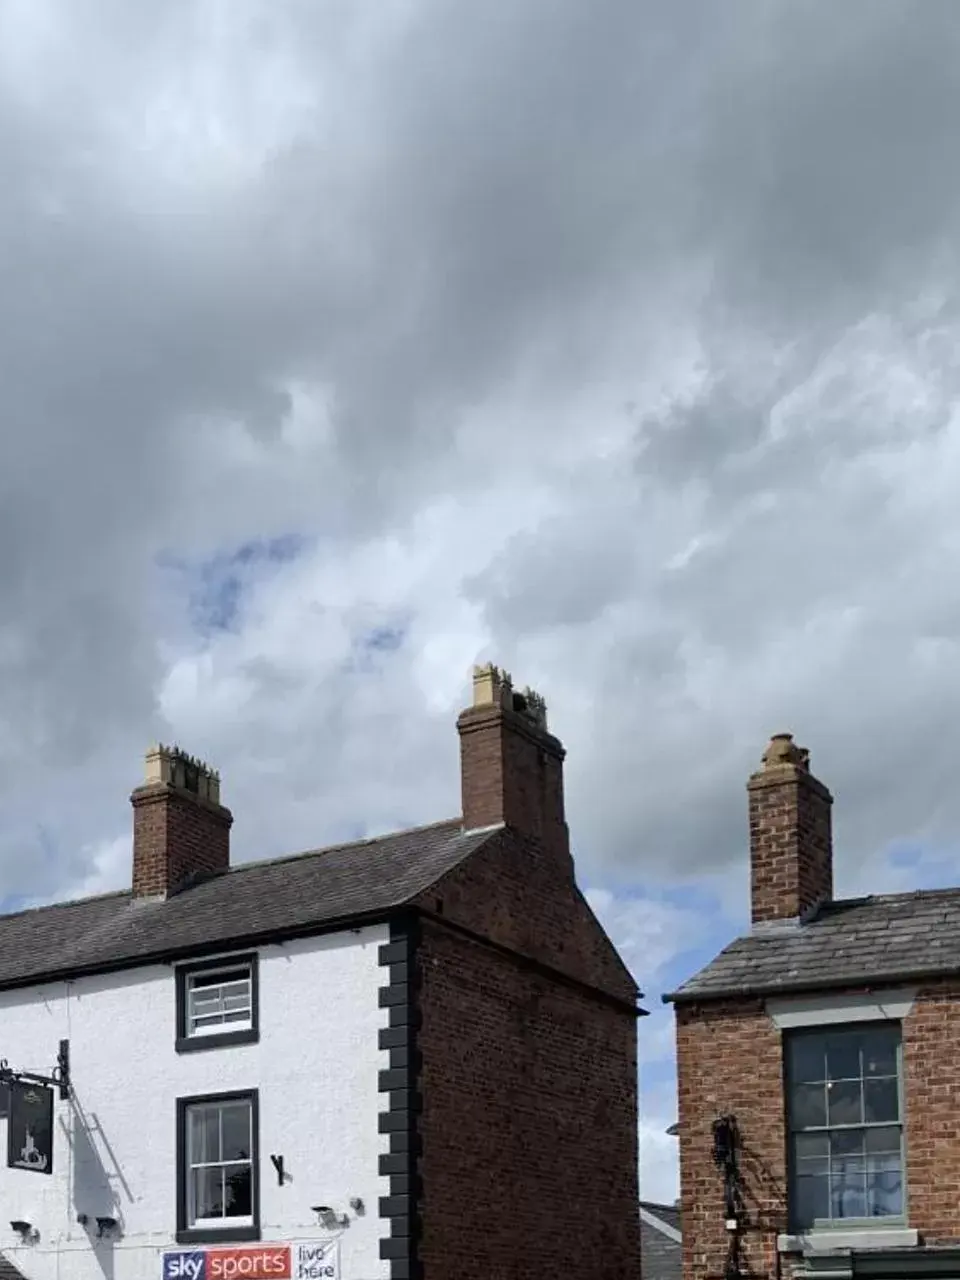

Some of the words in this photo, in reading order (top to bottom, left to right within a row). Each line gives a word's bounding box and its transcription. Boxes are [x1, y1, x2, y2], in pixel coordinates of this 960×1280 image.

[298, 1244, 326, 1262] live
[167, 1254, 204, 1280] sky
[211, 1251, 286, 1279] sports
[298, 1263, 335, 1279] here
